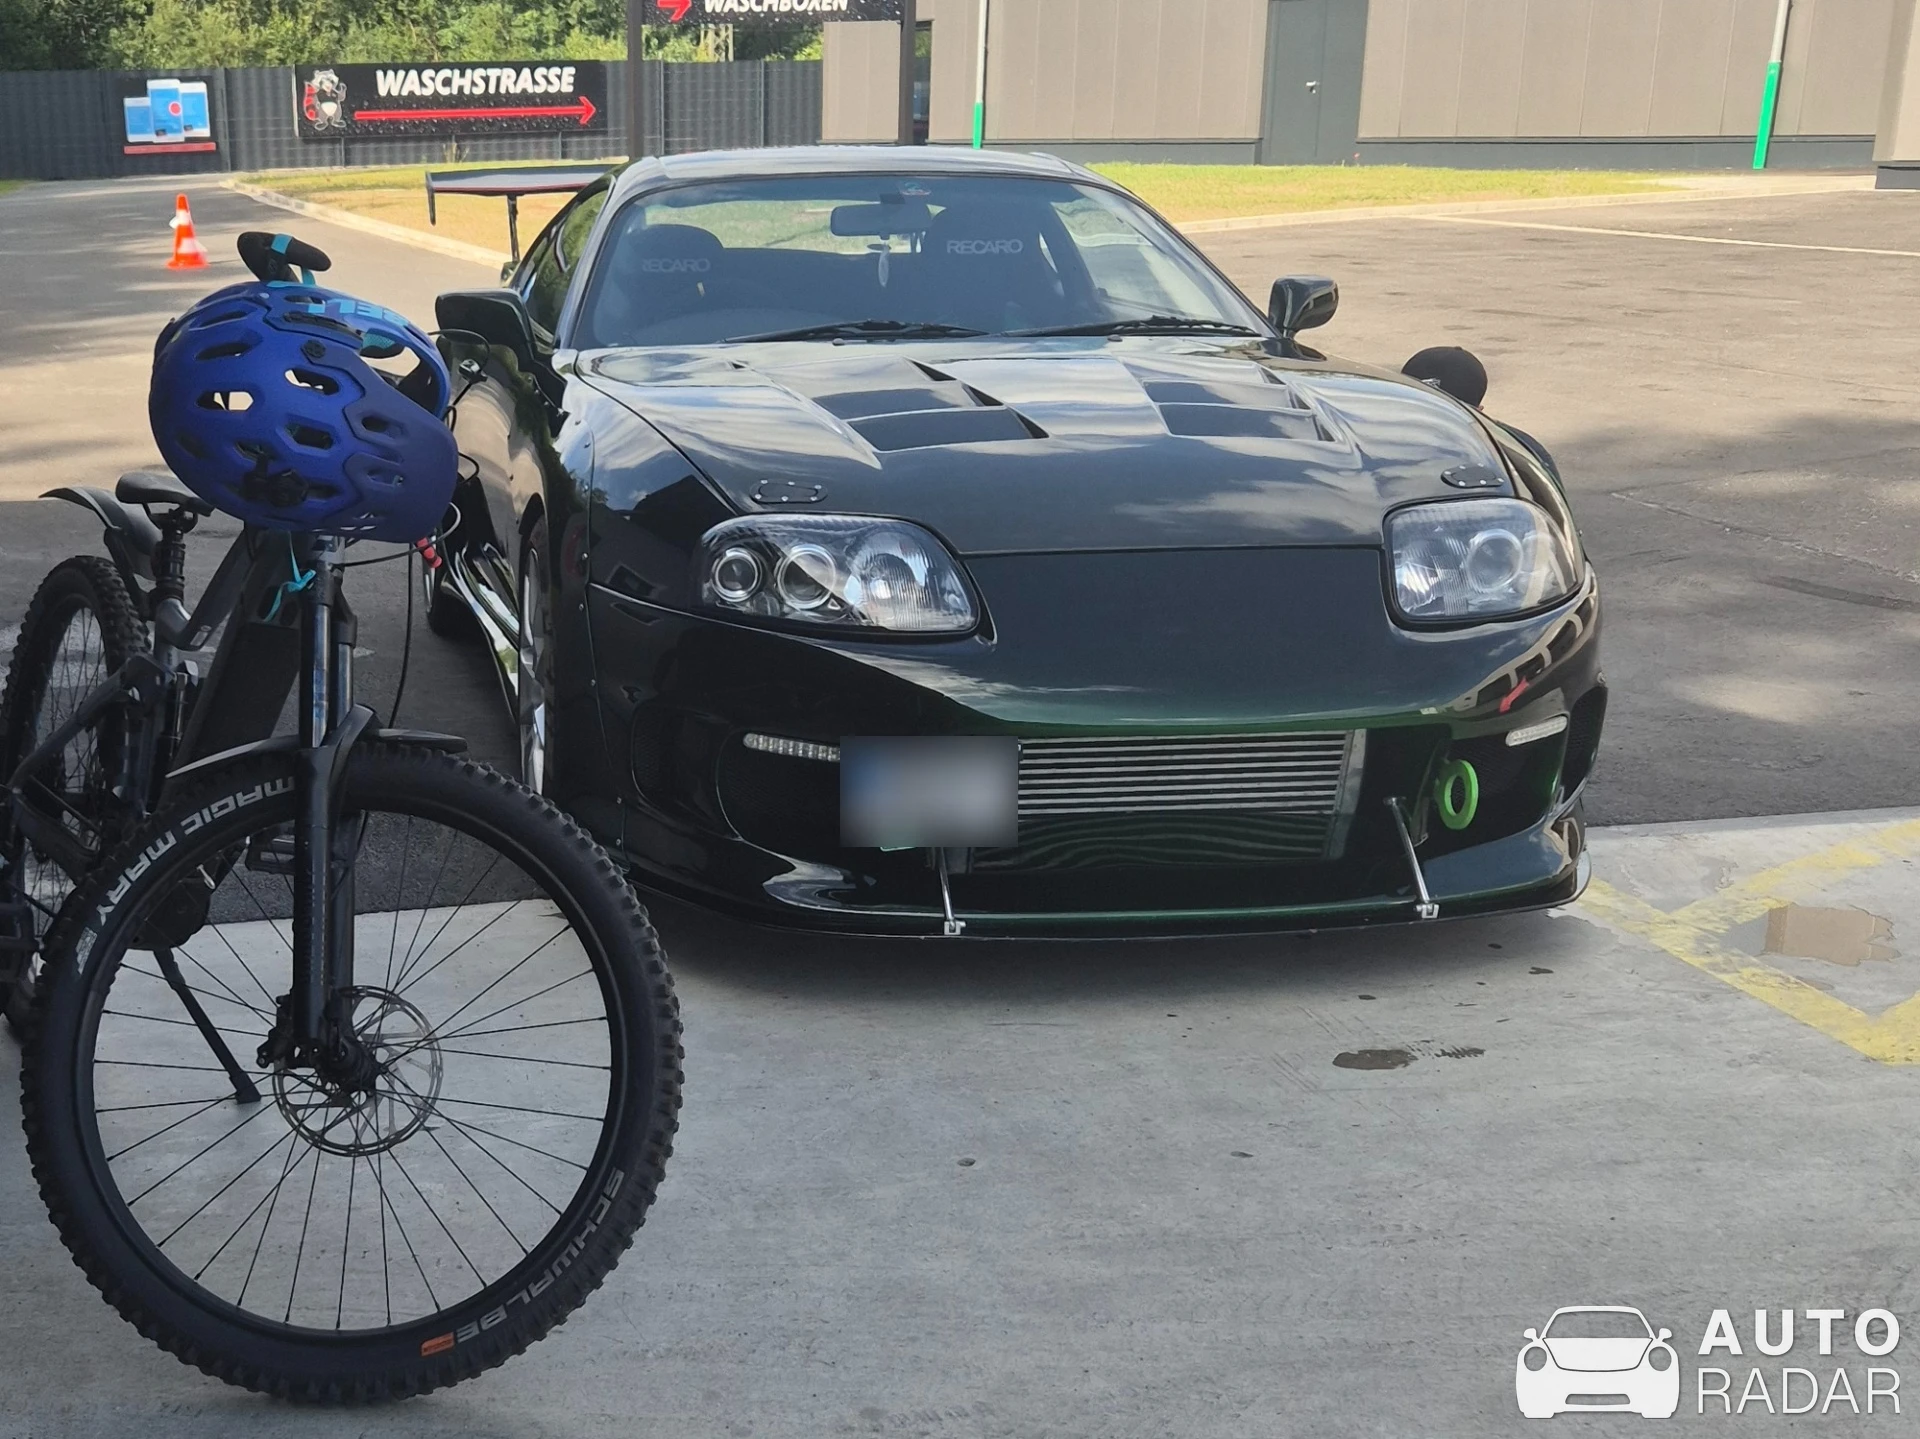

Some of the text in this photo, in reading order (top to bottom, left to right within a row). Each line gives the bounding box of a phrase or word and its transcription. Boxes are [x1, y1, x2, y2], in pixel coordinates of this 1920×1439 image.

[703, 0, 848, 13] WASCHBOXEN
[375, 66, 577, 97] WASCHSTRASSE
[946, 238, 1024, 254] RECARO
[96, 775, 296, 927] MAGIC MARY
[456, 1166, 625, 1344] SCHWALBE
